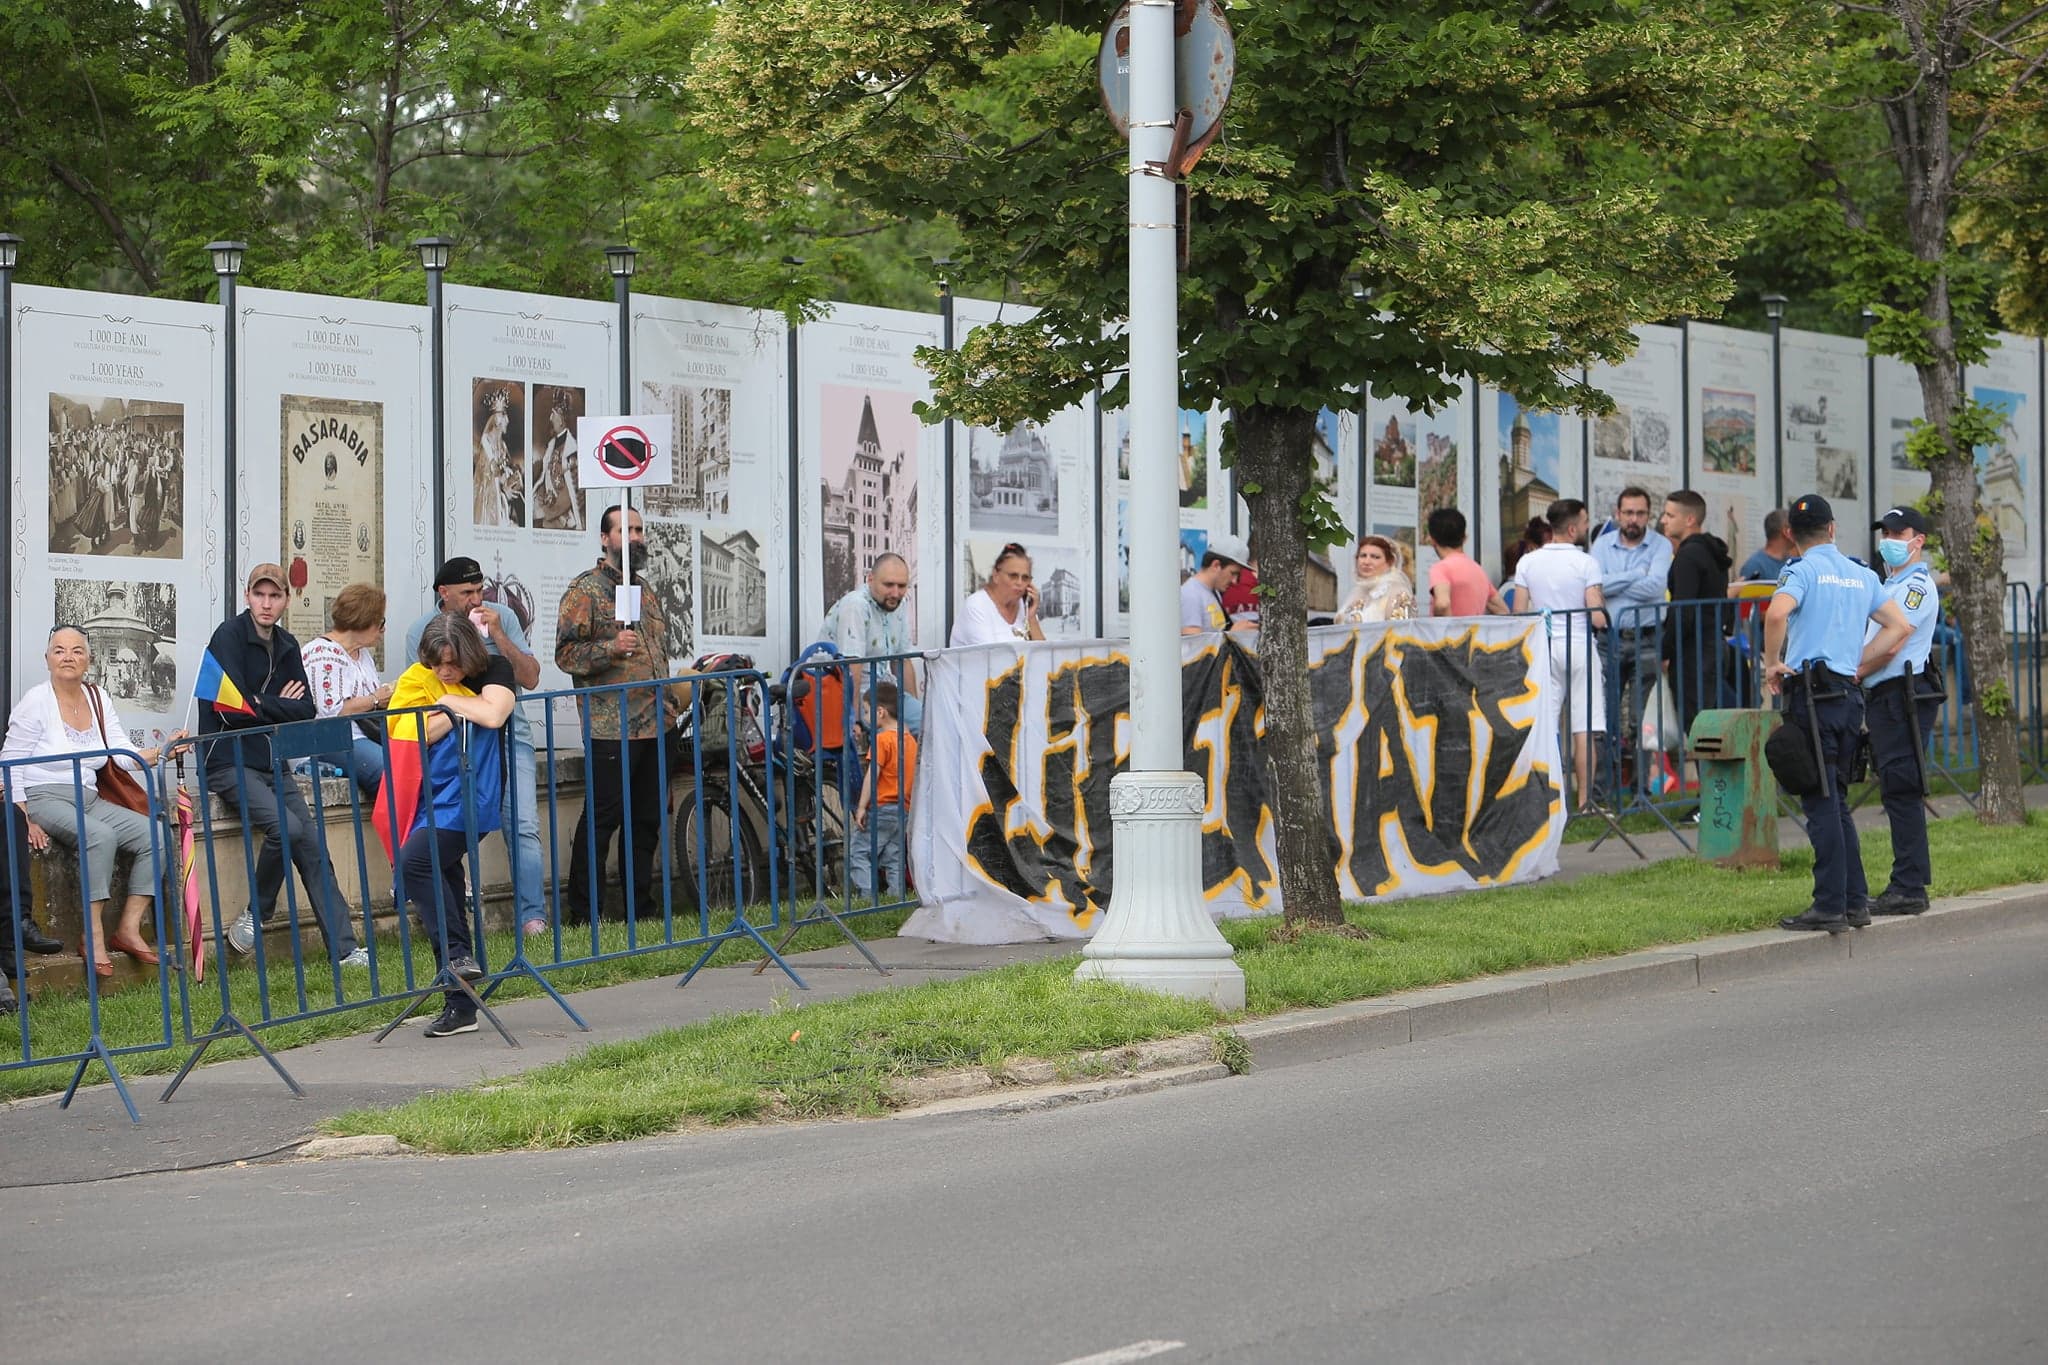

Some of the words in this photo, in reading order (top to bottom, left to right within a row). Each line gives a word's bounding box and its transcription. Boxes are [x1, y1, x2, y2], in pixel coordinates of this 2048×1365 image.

[96, 330, 112, 343] 000
[114, 331, 127, 345] DE
[129, 333, 148, 347] ANI
[312, 330, 327, 343] 000
[329, 331, 341, 345] DE
[343, 333, 359, 347] ANI
[511, 327, 525, 338] 000
[526, 328, 537, 340] DE
[540, 329, 554, 341] ANI
[314, 362, 329, 375] 000
[331, 363, 357, 378] YEARS
[513, 355, 527, 368] 000
[528, 356, 552, 370] YEARS
[98, 363, 114, 376] 000
[115, 364, 144, 379] YEARS
[292, 417, 369, 467] BASARABIA
